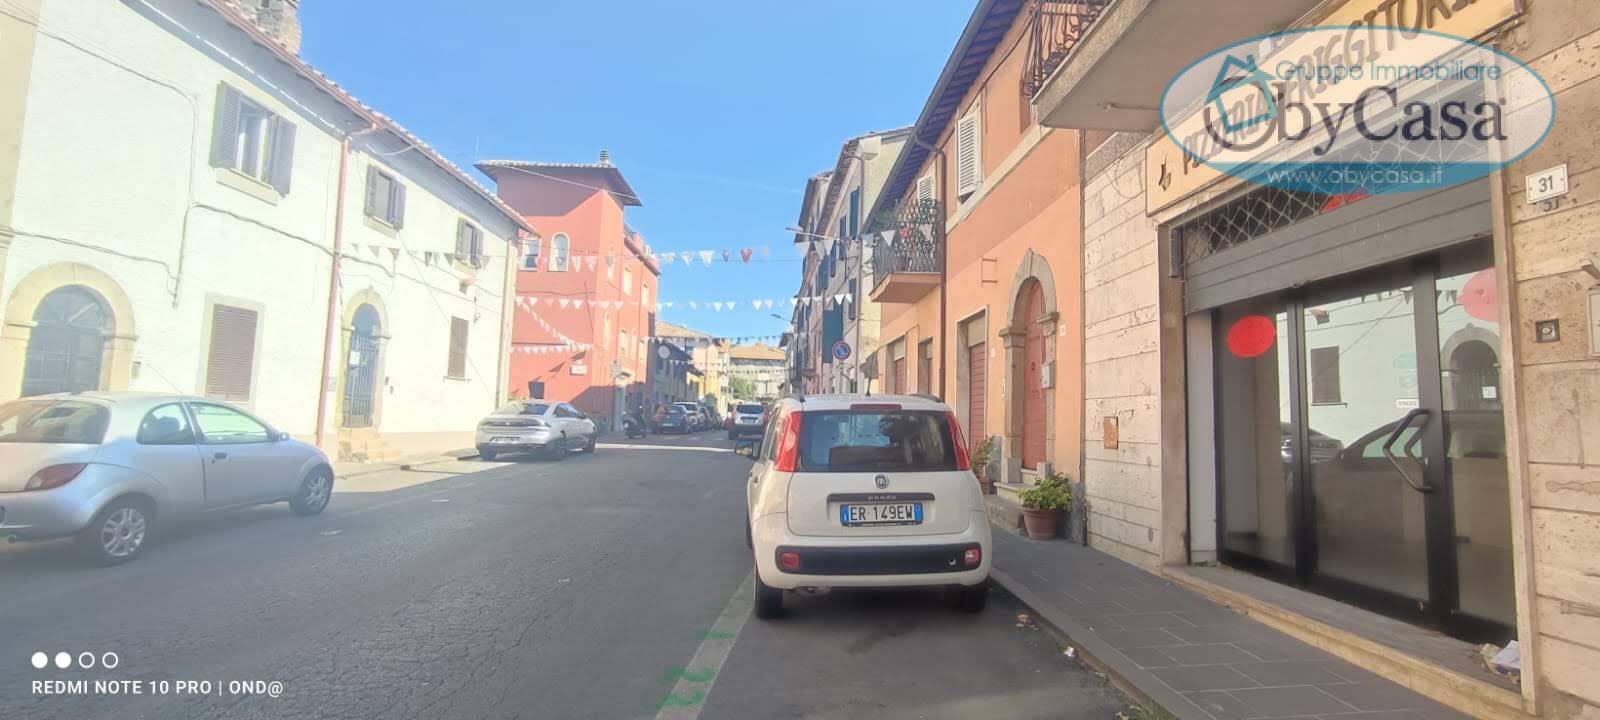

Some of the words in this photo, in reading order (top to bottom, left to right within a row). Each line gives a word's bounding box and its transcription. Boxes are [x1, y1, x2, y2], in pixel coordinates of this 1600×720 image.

[1538, 175, 1553, 192] 31
[850, 506, 866, 521] ER
[873, 505, 913, 521] 149EW
